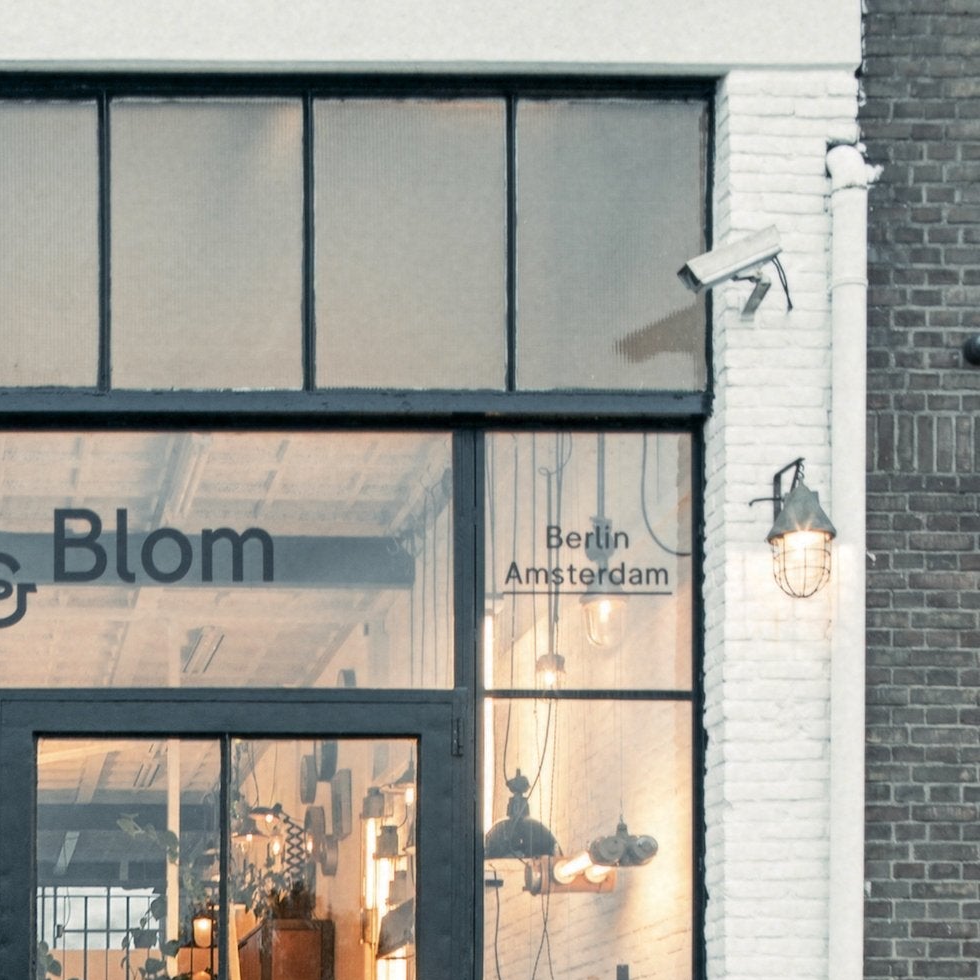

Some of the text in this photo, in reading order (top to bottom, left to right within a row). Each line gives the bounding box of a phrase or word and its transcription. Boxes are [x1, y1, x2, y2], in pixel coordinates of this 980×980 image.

[53, 507, 275, 584] Blom
[546, 525, 630, 549] Berlin
[504, 561, 669, 585] Amsterdam
